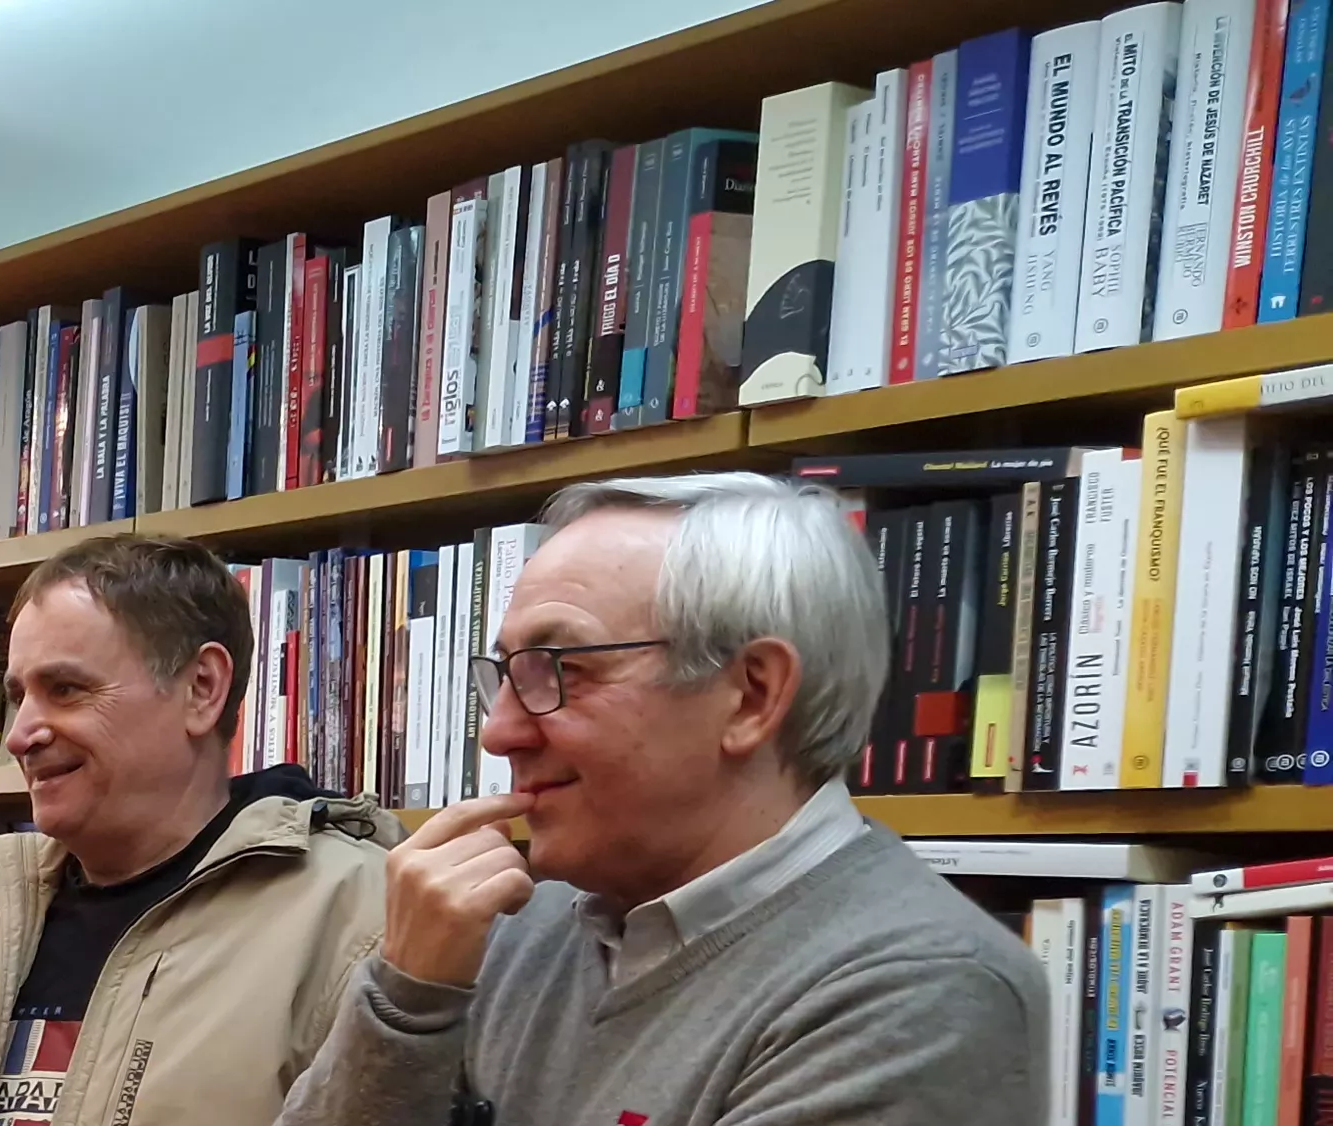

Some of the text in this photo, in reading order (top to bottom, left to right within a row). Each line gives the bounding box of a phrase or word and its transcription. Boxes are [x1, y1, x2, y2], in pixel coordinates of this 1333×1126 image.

[1052, 54, 1073, 77] EL
[1121, 43, 1138, 77] MITO
[1046, 80, 1071, 147] MUNDO
[1207, 90, 1220, 105] DE
[1112, 100, 1133, 177] TRANSICIÓN
[1204, 107, 1220, 140] JESÚS
[1043, 152, 1063, 175] AL
[1202, 142, 1214, 157] DE
[1197, 158, 1213, 206] NAZARET
[1233, 125, 1264, 269] WINSTON CHURCHILL
[1039, 178, 1063, 238] REVÉS
[1106, 179, 1127, 239] PACÍFICA
[1270, 191, 1286, 258] HISTORIA
[1092, 246, 1109, 299] BABY
[600, 253, 621, 337] TRIGG EL DÍA D
[22, 389, 33, 428] Aragón
[100, 375, 110, 417] PALABRA
[440, 369, 460, 427] riglos
[98, 418, 109, 431] LA
[96, 440, 107, 466] BALA
[115, 453, 127, 468] EL
[96, 467, 105, 479] LA
[113, 470, 126, 500] ¡VIVA
[1305, 477, 1314, 495] LOS
[1085, 472, 1100, 523] FRANCISCO
[1100, 487, 1114, 522] FUSTER
[1149, 427, 1171, 582] ¿QUÉ FUE EL FRANQUISMO?
[1302, 496, 1313, 527] POCOS
[496, 540, 505, 578] Escritos
[503, 539, 518, 579] Pablo
[1044, 496, 1062, 621] José Carlos Bermejo Barrera
[1083, 543, 1095, 587] moderno
[1299, 538, 1310, 556] LOS
[936, 587, 947, 598] La
[996, 583, 1010, 607] Jorge
[1248, 587, 1258, 600] NO
[1283, 567, 1294, 600] ISRAEL
[1296, 557, 1308, 600] MEJORES
[1077, 599, 1091, 635] Clásico
[269, 645, 280, 709] MONTESCOS
[1068, 654, 1104, 748] AZORÍN
[268, 727, 277, 768] ULETOS
[1138, 899, 1153, 950] DEMOCRACIA
[1141, 951, 1151, 962] LA
[1167, 902, 1185, 994] ADAM GRANT
[1136, 970, 1150, 994] JAQUE
[1133, 1034, 1147, 1060] BOSCH
[1161, 1049, 1179, 1118] POTENCIAL
